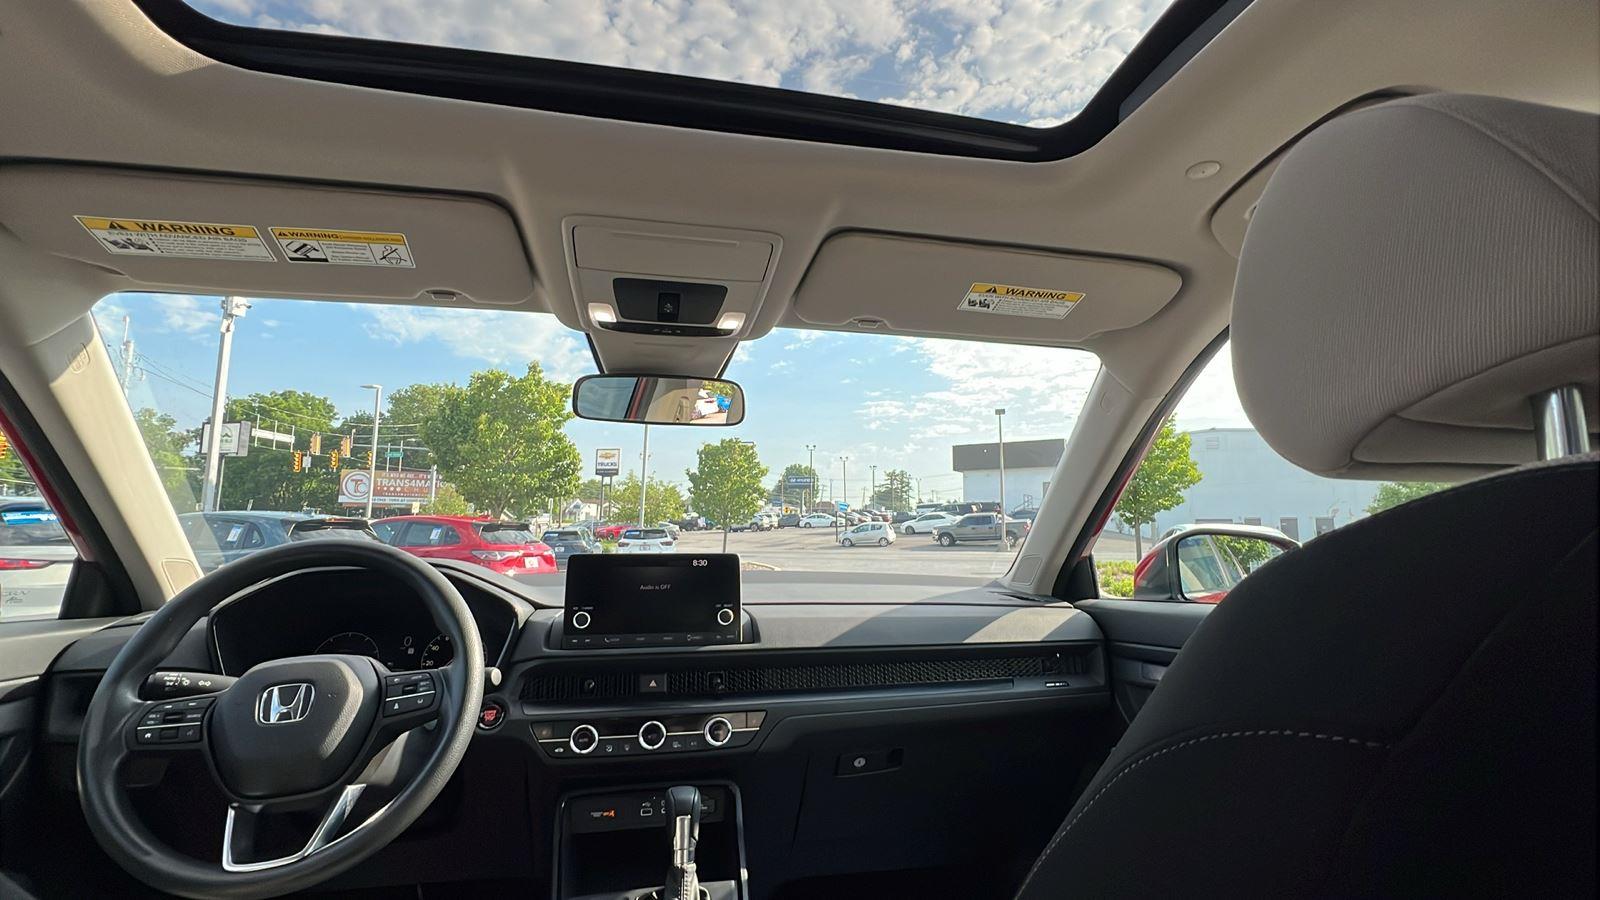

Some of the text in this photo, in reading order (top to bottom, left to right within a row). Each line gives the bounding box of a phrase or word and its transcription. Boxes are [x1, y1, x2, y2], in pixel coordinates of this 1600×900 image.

[135, 221, 236, 236] WARNING
[1005, 287, 1067, 300] WARNING
[692, 559, 708, 567] 8:30
